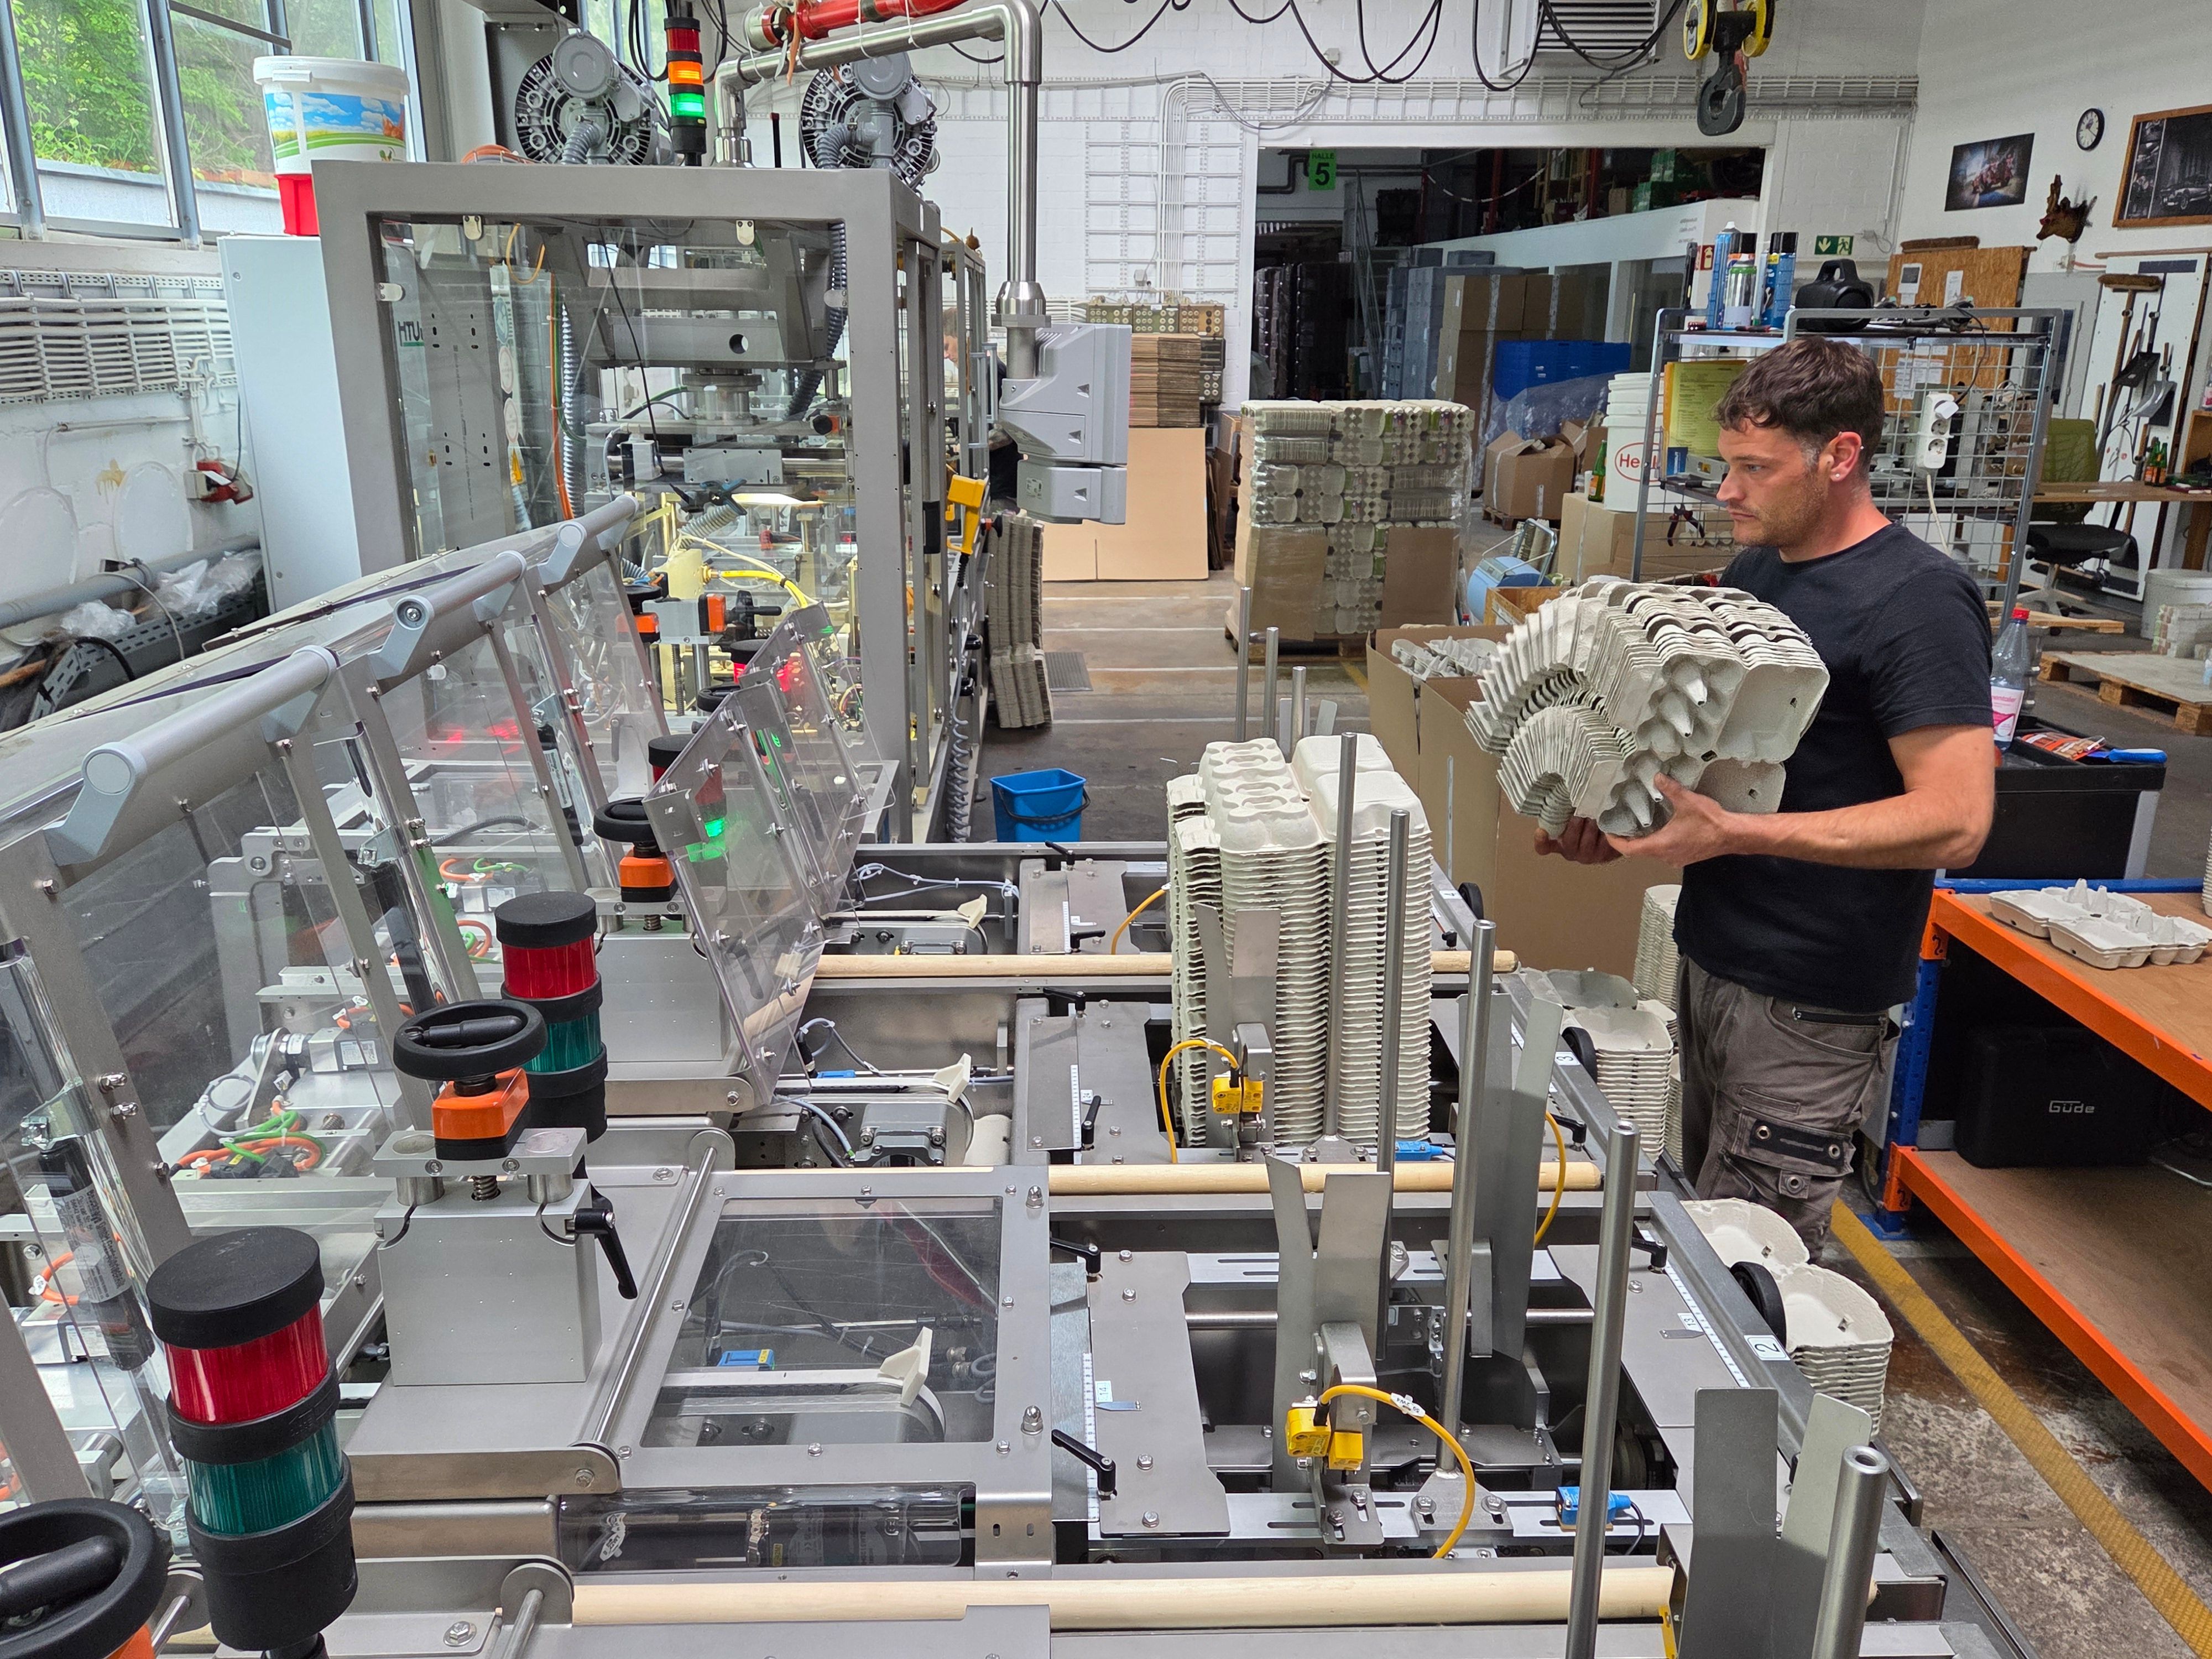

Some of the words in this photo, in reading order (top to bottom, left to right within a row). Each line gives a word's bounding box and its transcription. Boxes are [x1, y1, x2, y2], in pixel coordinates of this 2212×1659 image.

[1315, 163, 1330, 185] 5
[2049, 1100, 2095, 1113] Güde
[1684, 1318, 1696, 1326] 13
[1754, 1343, 1781, 1353] 2
